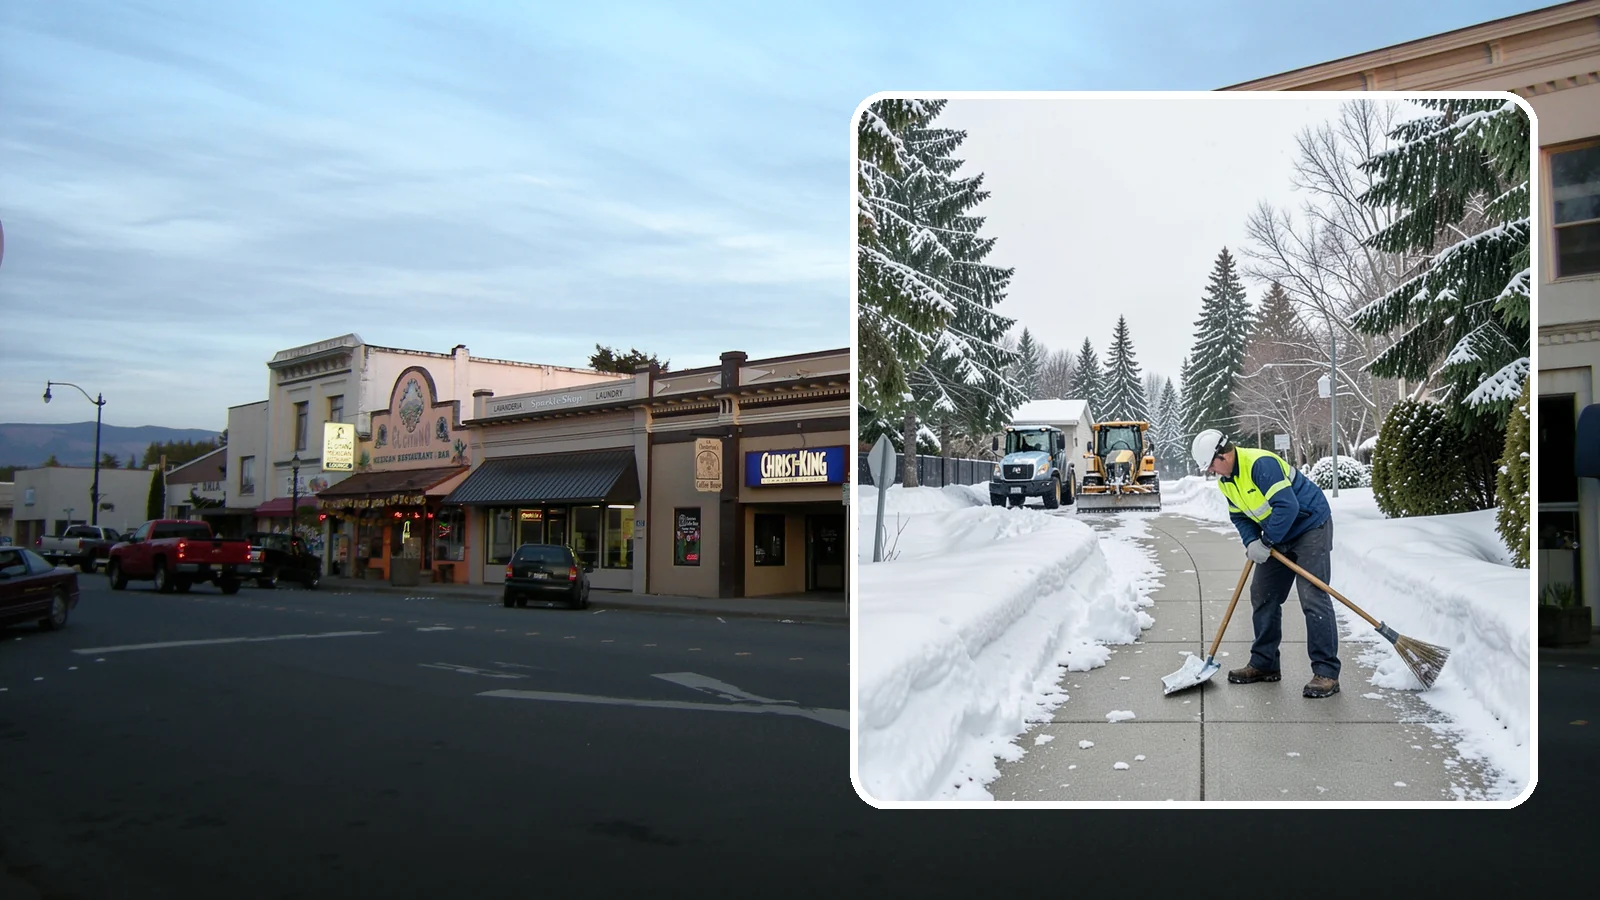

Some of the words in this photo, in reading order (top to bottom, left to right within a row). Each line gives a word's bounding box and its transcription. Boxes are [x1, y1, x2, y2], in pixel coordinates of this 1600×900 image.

[494, 402, 522, 412] LAVANDERIA
[531, 397, 560, 408] Sparkle
[561, 395, 582, 407] Shop
[596, 389, 623, 400] LAUNDRY
[398, 452, 433, 462] RESTAURANT
[761, 452, 797, 478] CHRIST
[799, 450, 827, 476] KING
